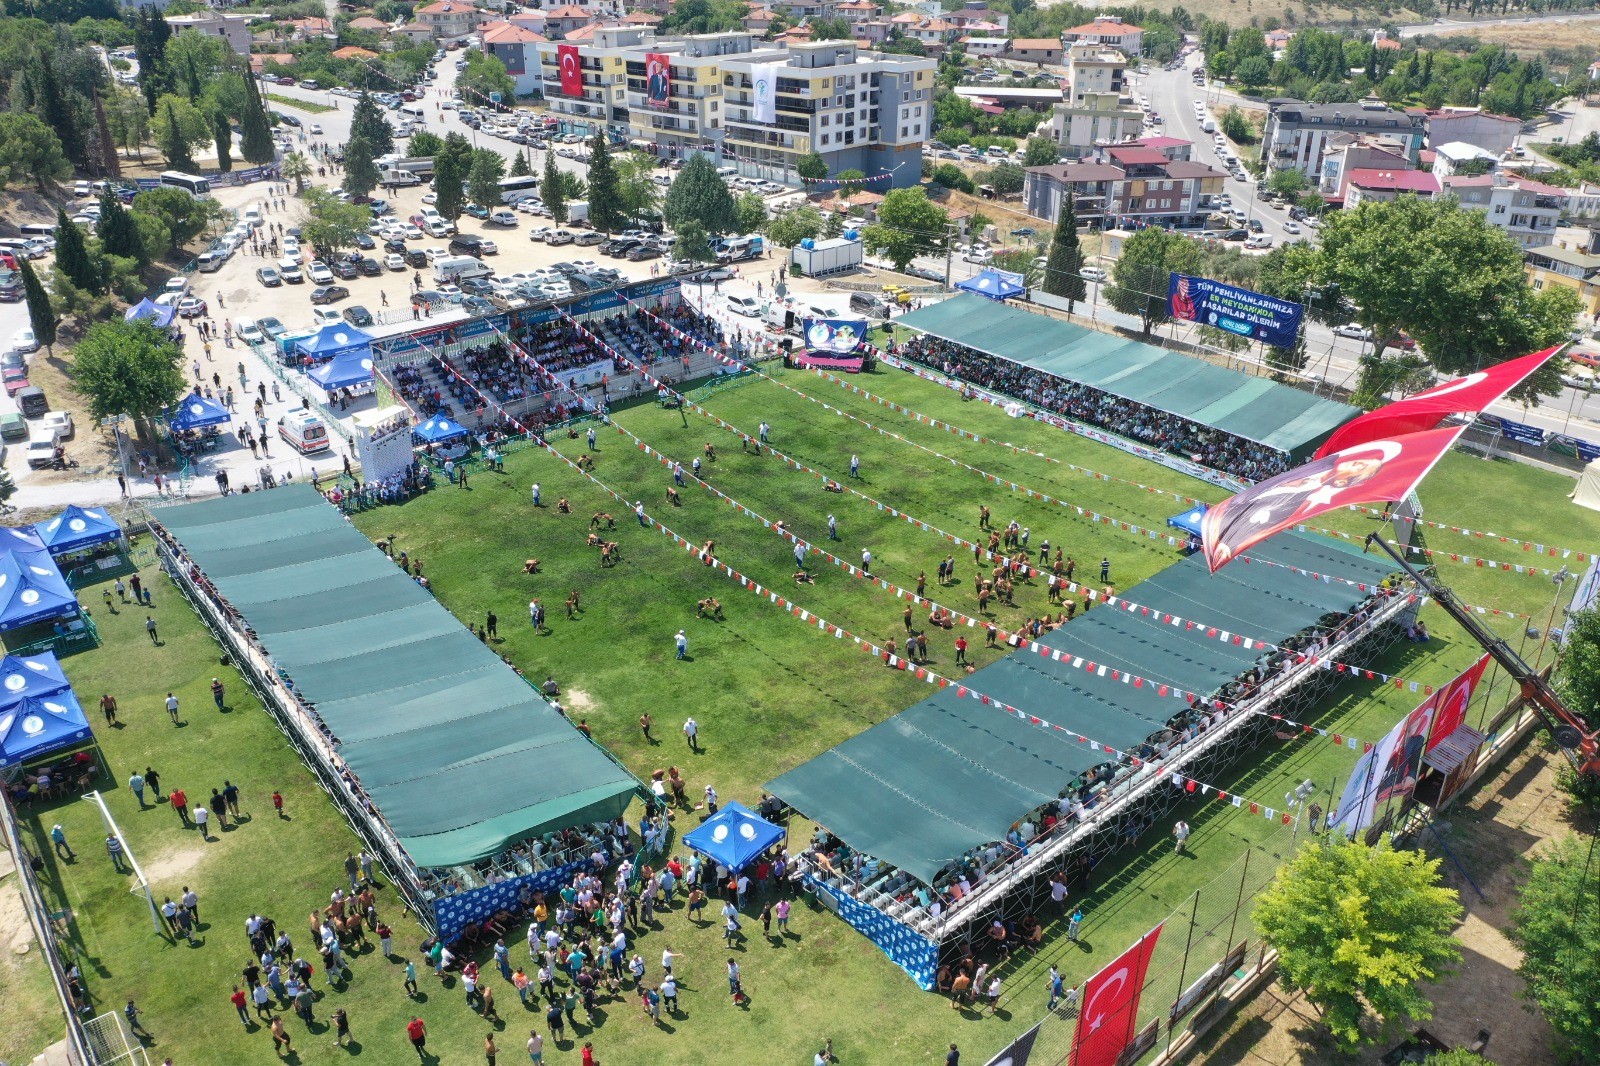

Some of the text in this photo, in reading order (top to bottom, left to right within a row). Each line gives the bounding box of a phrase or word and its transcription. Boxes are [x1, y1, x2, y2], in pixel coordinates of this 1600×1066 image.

[1196, 282, 1293, 315] TÜM PEHLİVANLARIMIZA
[1209, 293, 1274, 318] ER MEYDANINDA
[1202, 300, 1280, 330] BAŞARILAR DİLERİM
